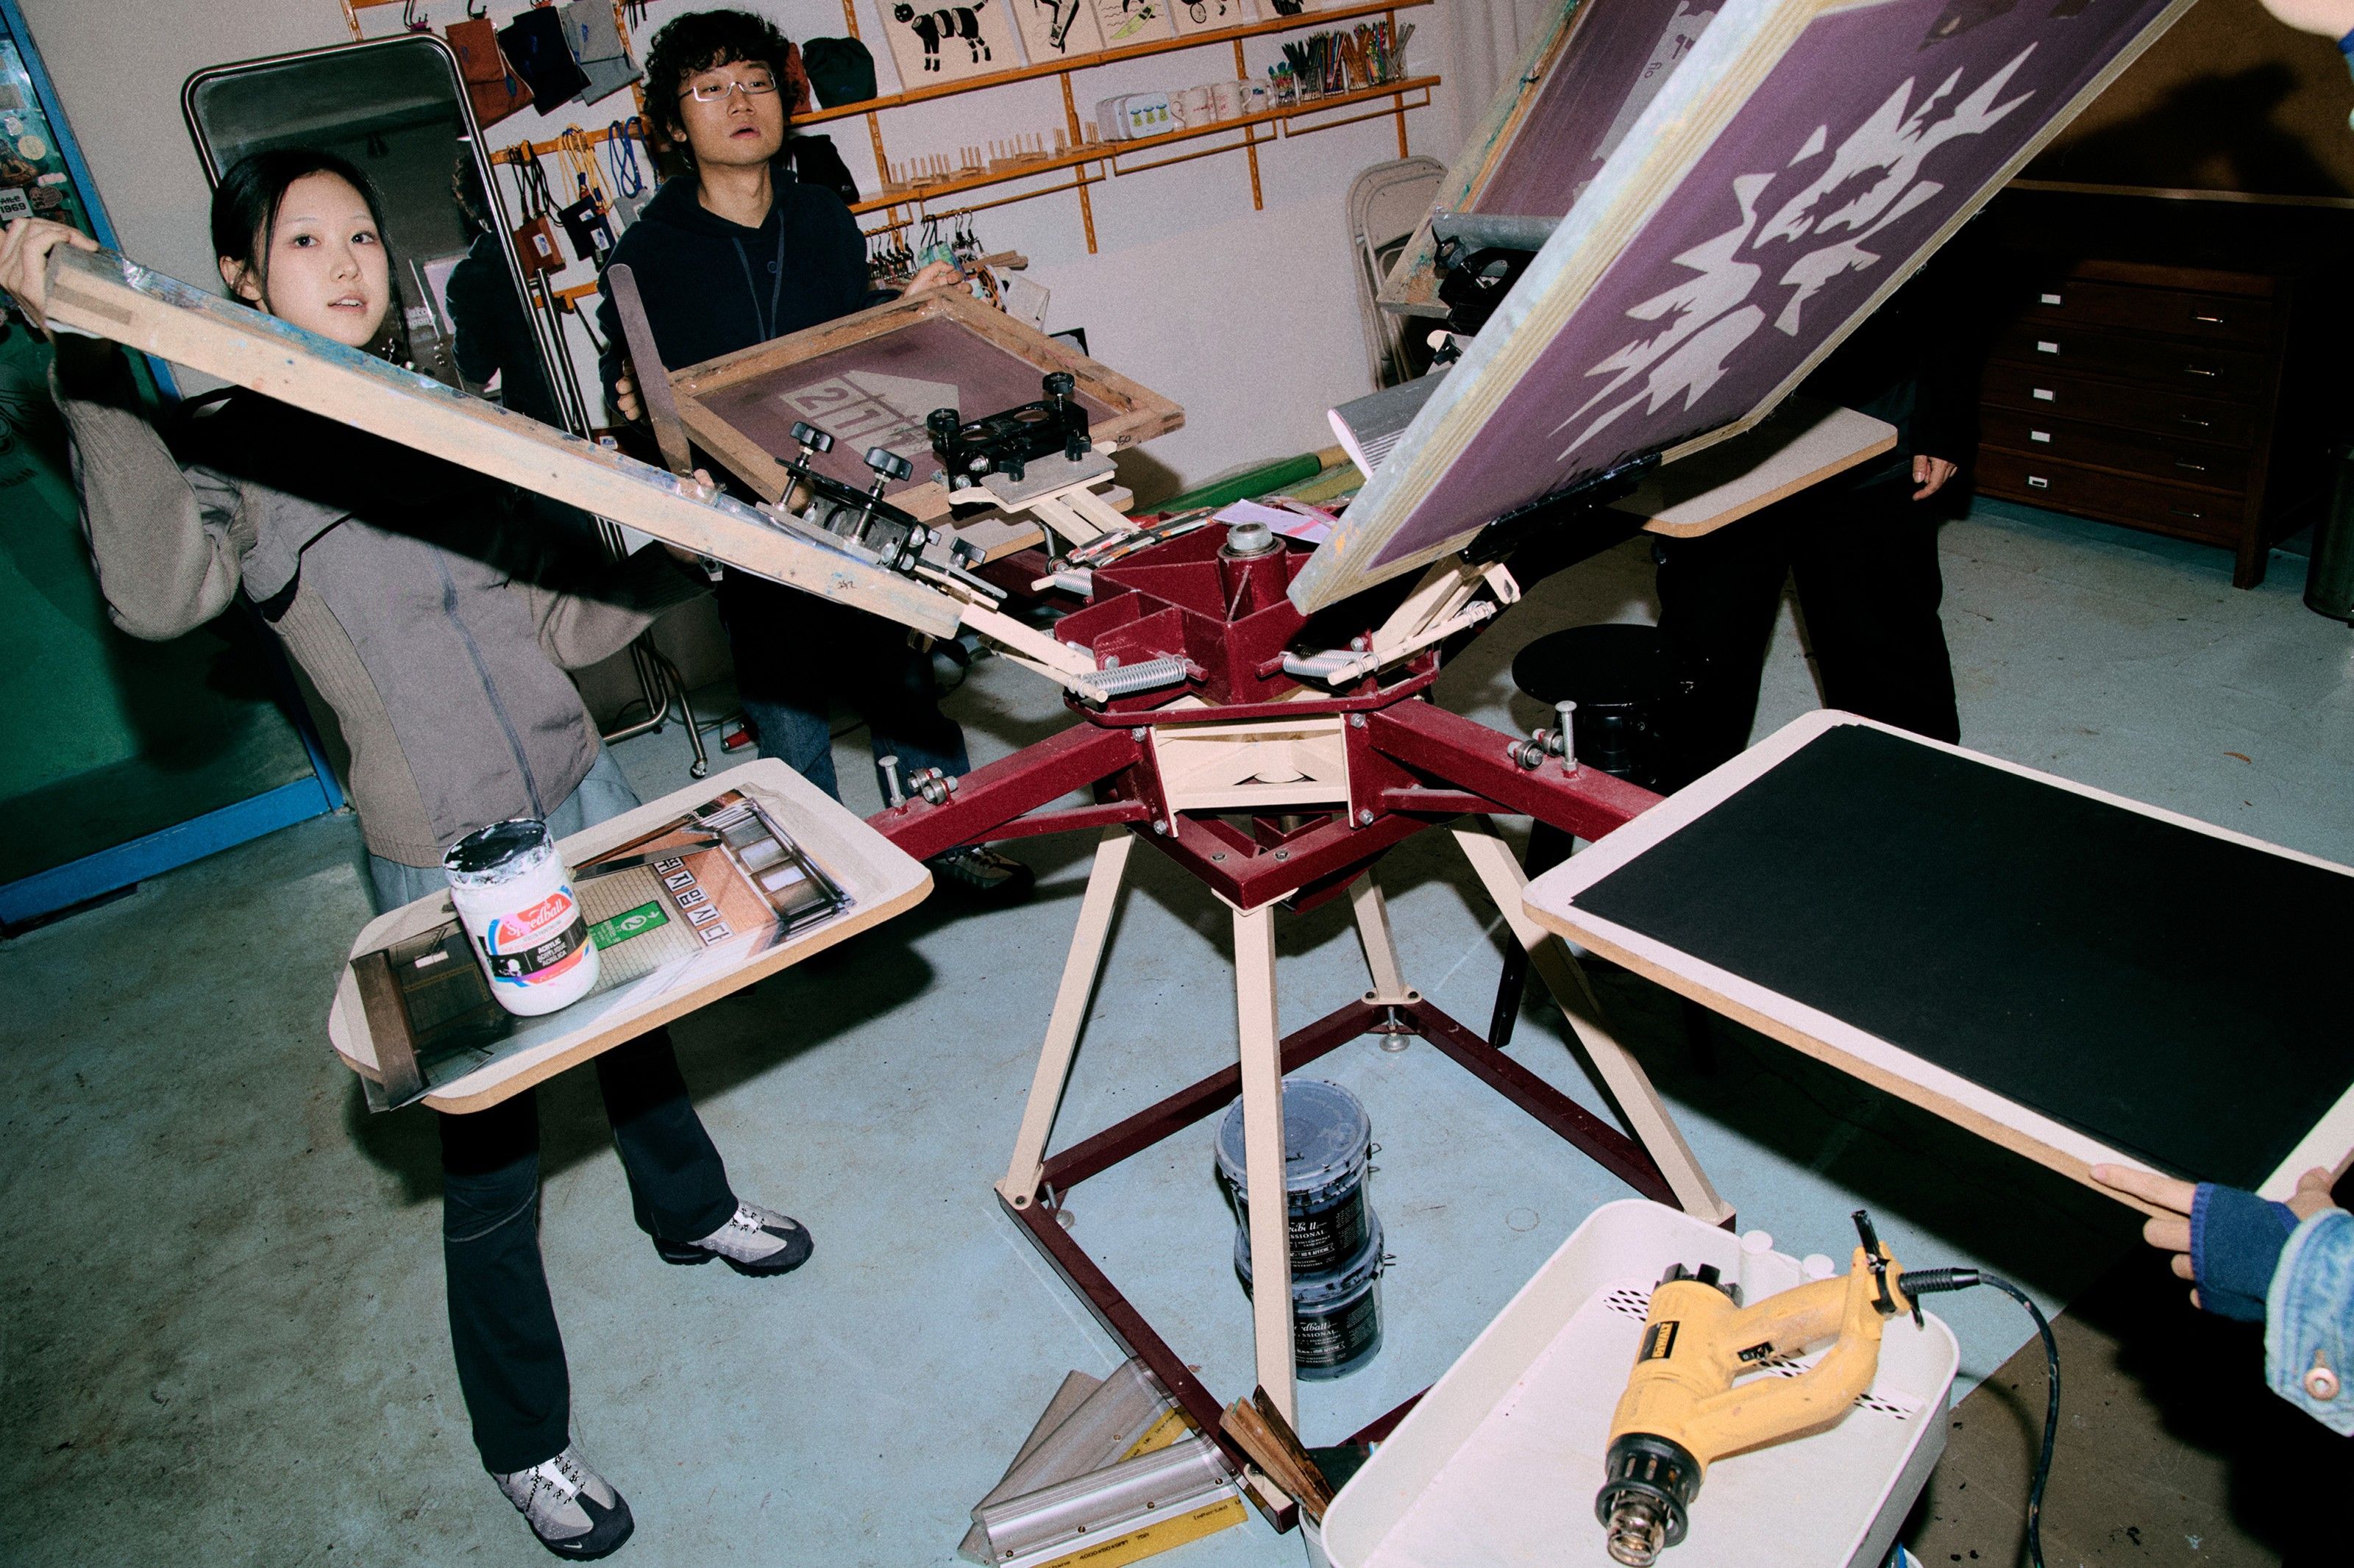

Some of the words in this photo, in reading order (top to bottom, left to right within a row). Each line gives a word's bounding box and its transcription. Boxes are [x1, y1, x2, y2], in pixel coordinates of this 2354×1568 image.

[0, 202, 26, 214] 1969
[506, 898, 565, 937] Spedball
[538, 938, 561, 954] ACRYLIC
